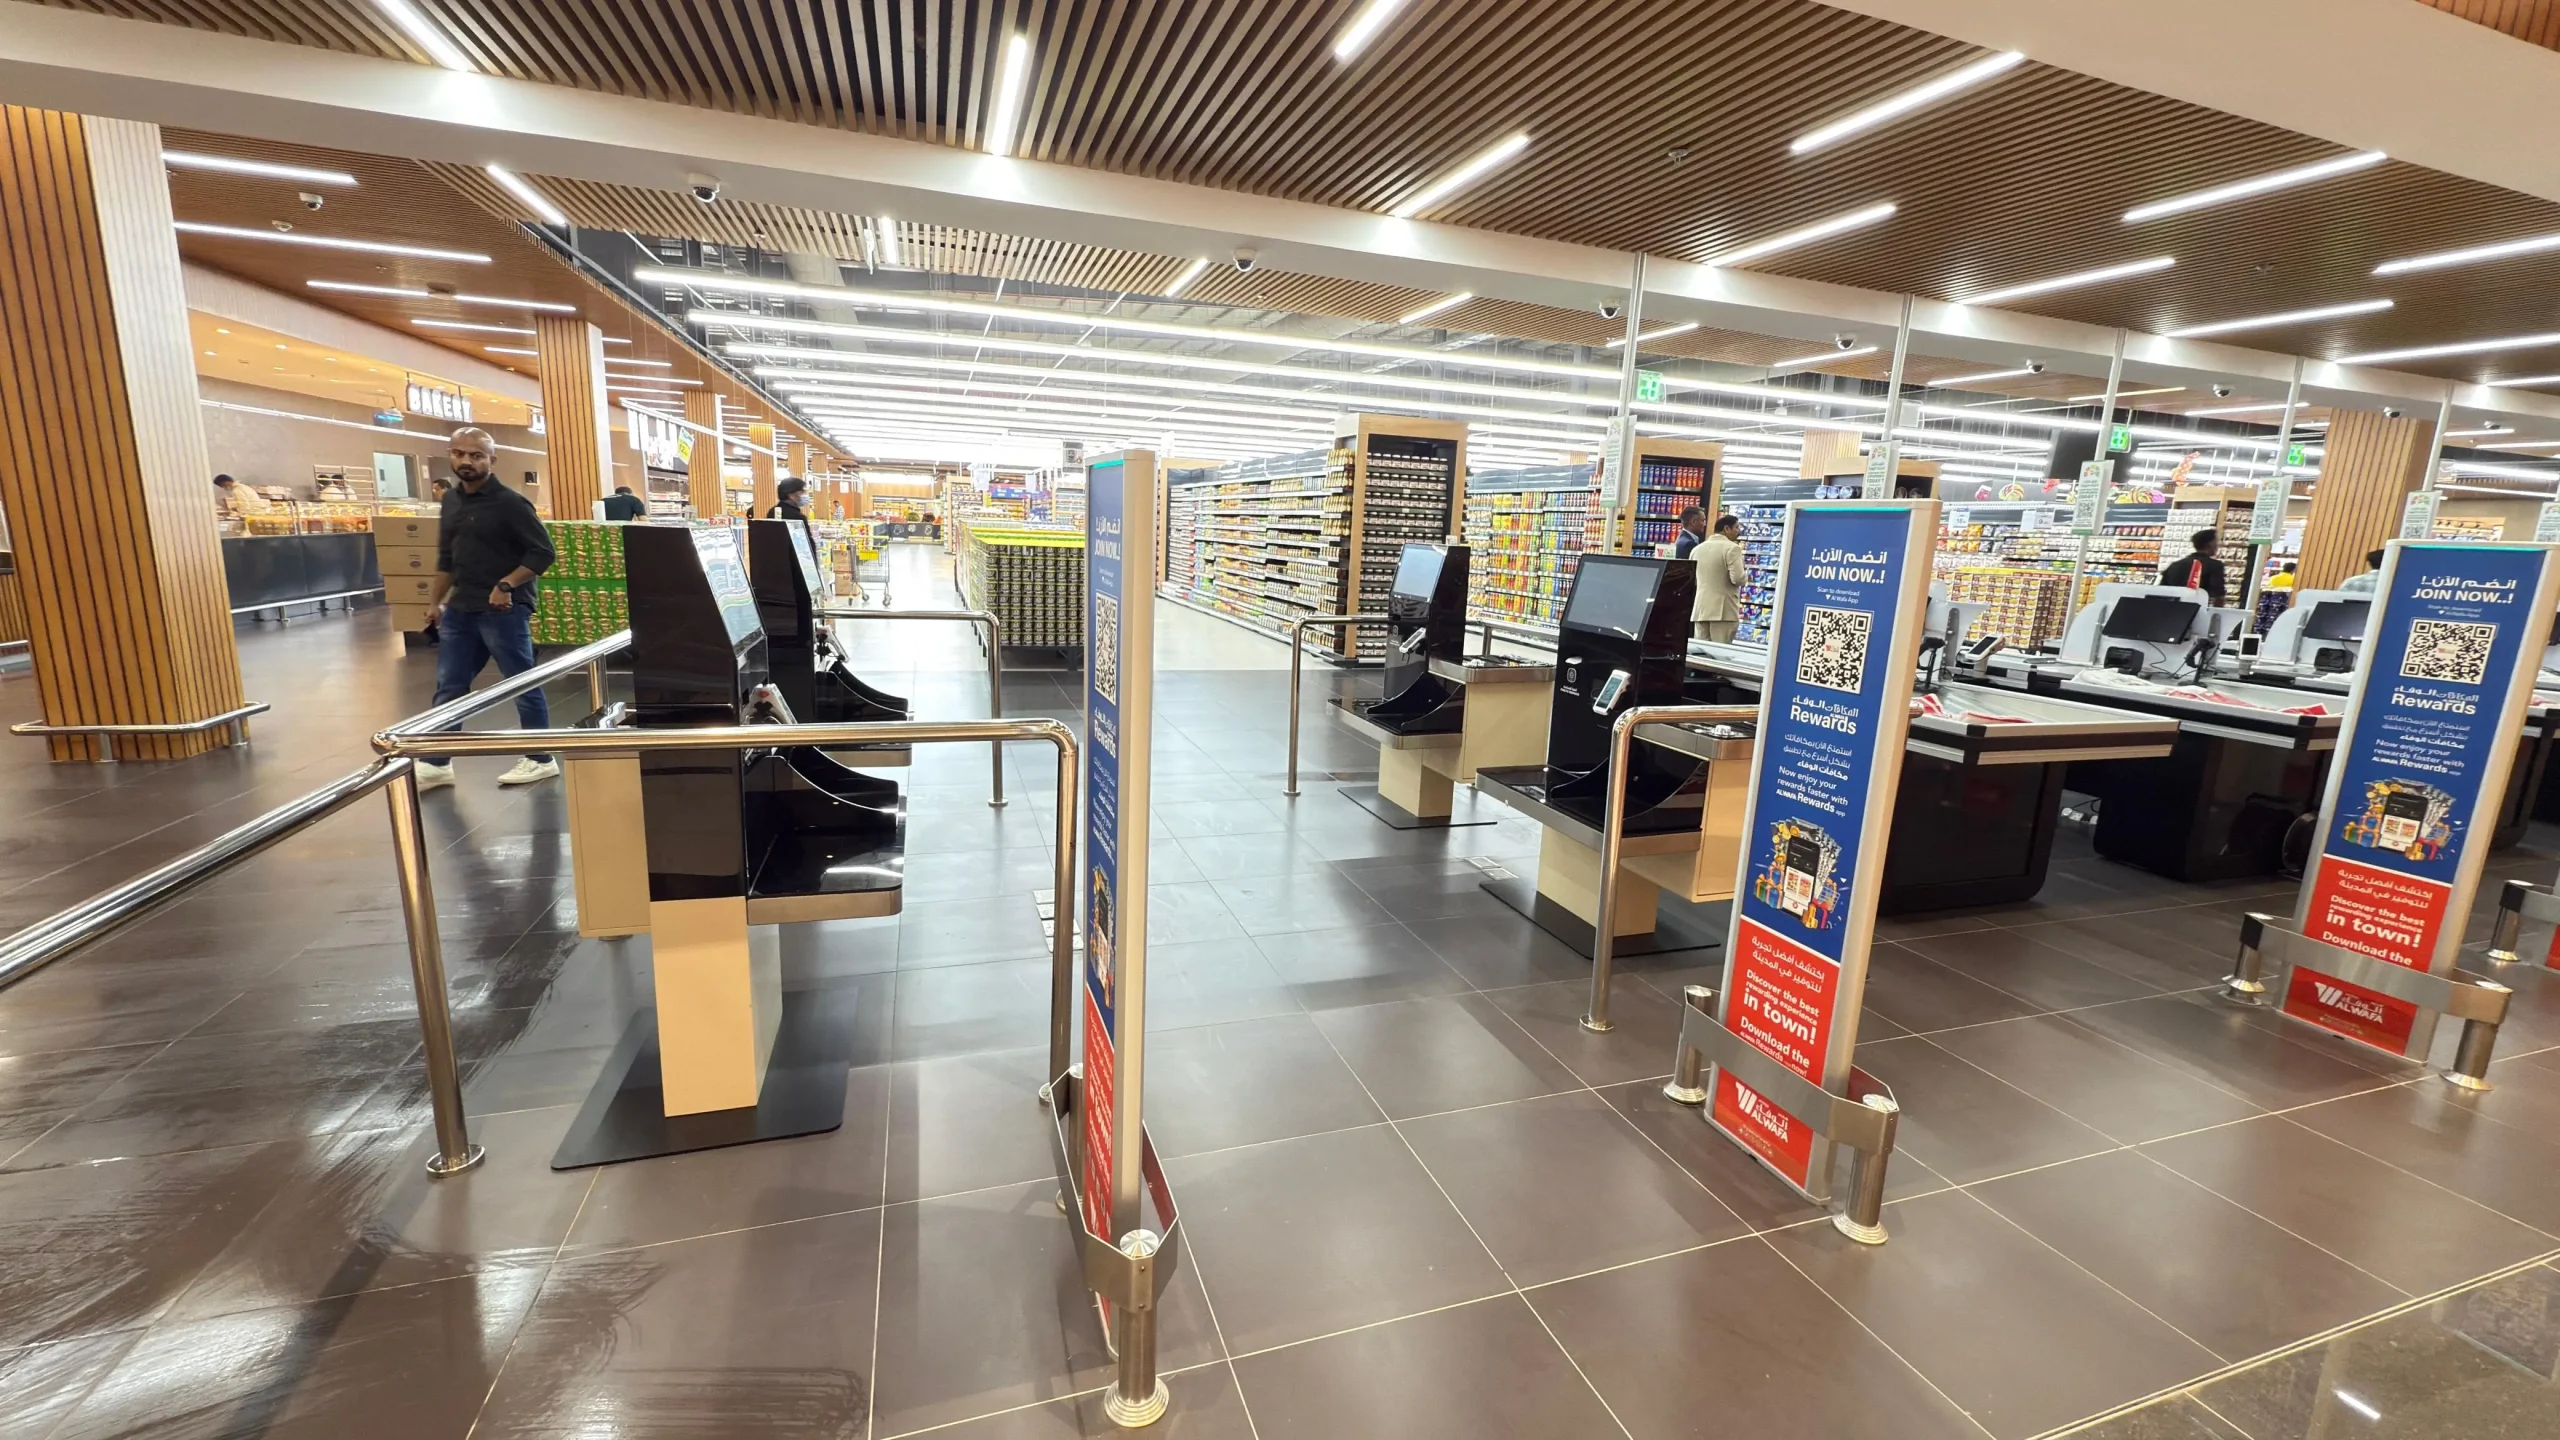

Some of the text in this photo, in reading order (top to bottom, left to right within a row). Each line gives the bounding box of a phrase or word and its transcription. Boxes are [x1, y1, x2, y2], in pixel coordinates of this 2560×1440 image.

[408, 383, 473, 423] BAKERY
[1843, 550, 1888, 565] انضم
[1805, 565, 1886, 585] JOIN NOW..!
[2461, 578, 2517, 589] انضم
[1835, 589, 1860, 597] download
[2411, 588, 2514, 604] JOIN NOW..!
[2391, 693, 2476, 715] Rewards
[1790, 704, 1857, 735] Rewards
[2373, 748, 2465, 768] rewards faster with
[2375, 738, 2451, 756] Now enjoy your
[1779, 765, 1837, 790] Now enjoy your
[2399, 758, 2448, 773] Rewards
[1777, 778, 1848, 806] rewards faster with
[1797, 792, 1835, 813] Rewards
[2330, 894, 2425, 927] Discover the best
[2326, 909, 2421, 948] in town!
[2322, 930, 2412, 966] Download the
[1745, 981, 1818, 1026] rewarding experience
[1746, 969, 1820, 1018] Discover the best
[1743, 987, 1817, 1045] in town!
[2335, 1001, 2383, 1024] ALWAFA
[1740, 1015, 1810, 1068] Download the
[1755, 1038, 1783, 1062] Rewards
[1751, 1110, 1788, 1143] ALWAFA
